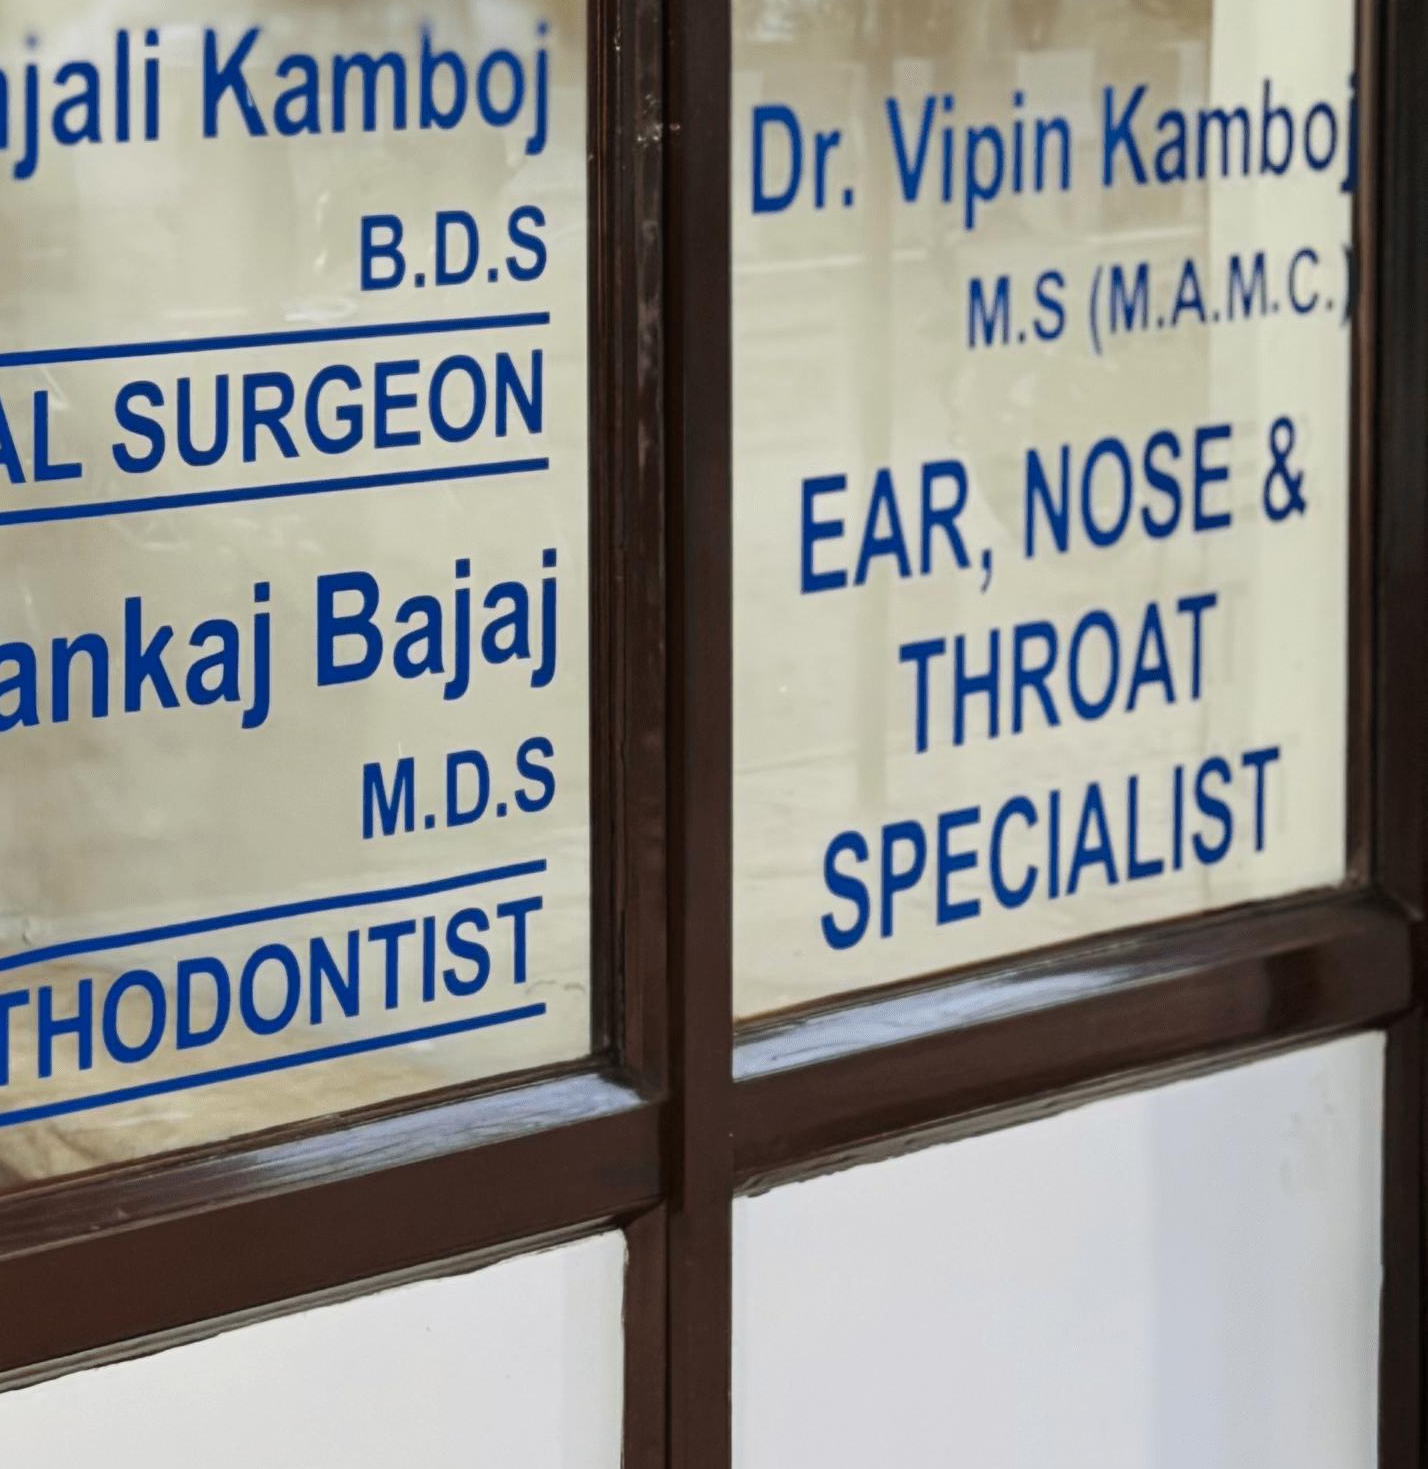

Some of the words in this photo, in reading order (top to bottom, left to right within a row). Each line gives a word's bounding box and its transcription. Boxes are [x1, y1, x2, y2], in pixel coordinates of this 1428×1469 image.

[202, 28, 548, 156] Kamboj
[751, 103, 855, 216] Dr.
[886, 92, 1072, 231] Vipin
[1101, 72, 1358, 194] Kamboj
[360, 205, 548, 292] B.D.S
[966, 270, 1066, 349] M.S
[111, 349, 544, 474] SURGEON
[800, 459, 995, 595] EAR,
[1025, 425, 1232, 558] NOSE
[1262, 416, 1309, 523] &
[315, 548, 558, 701] Bajaj
[898, 592, 1219, 754] THROAT
[361, 736, 556, 840] M.D.S
[820, 747, 1282, 951] SPECIALIST
